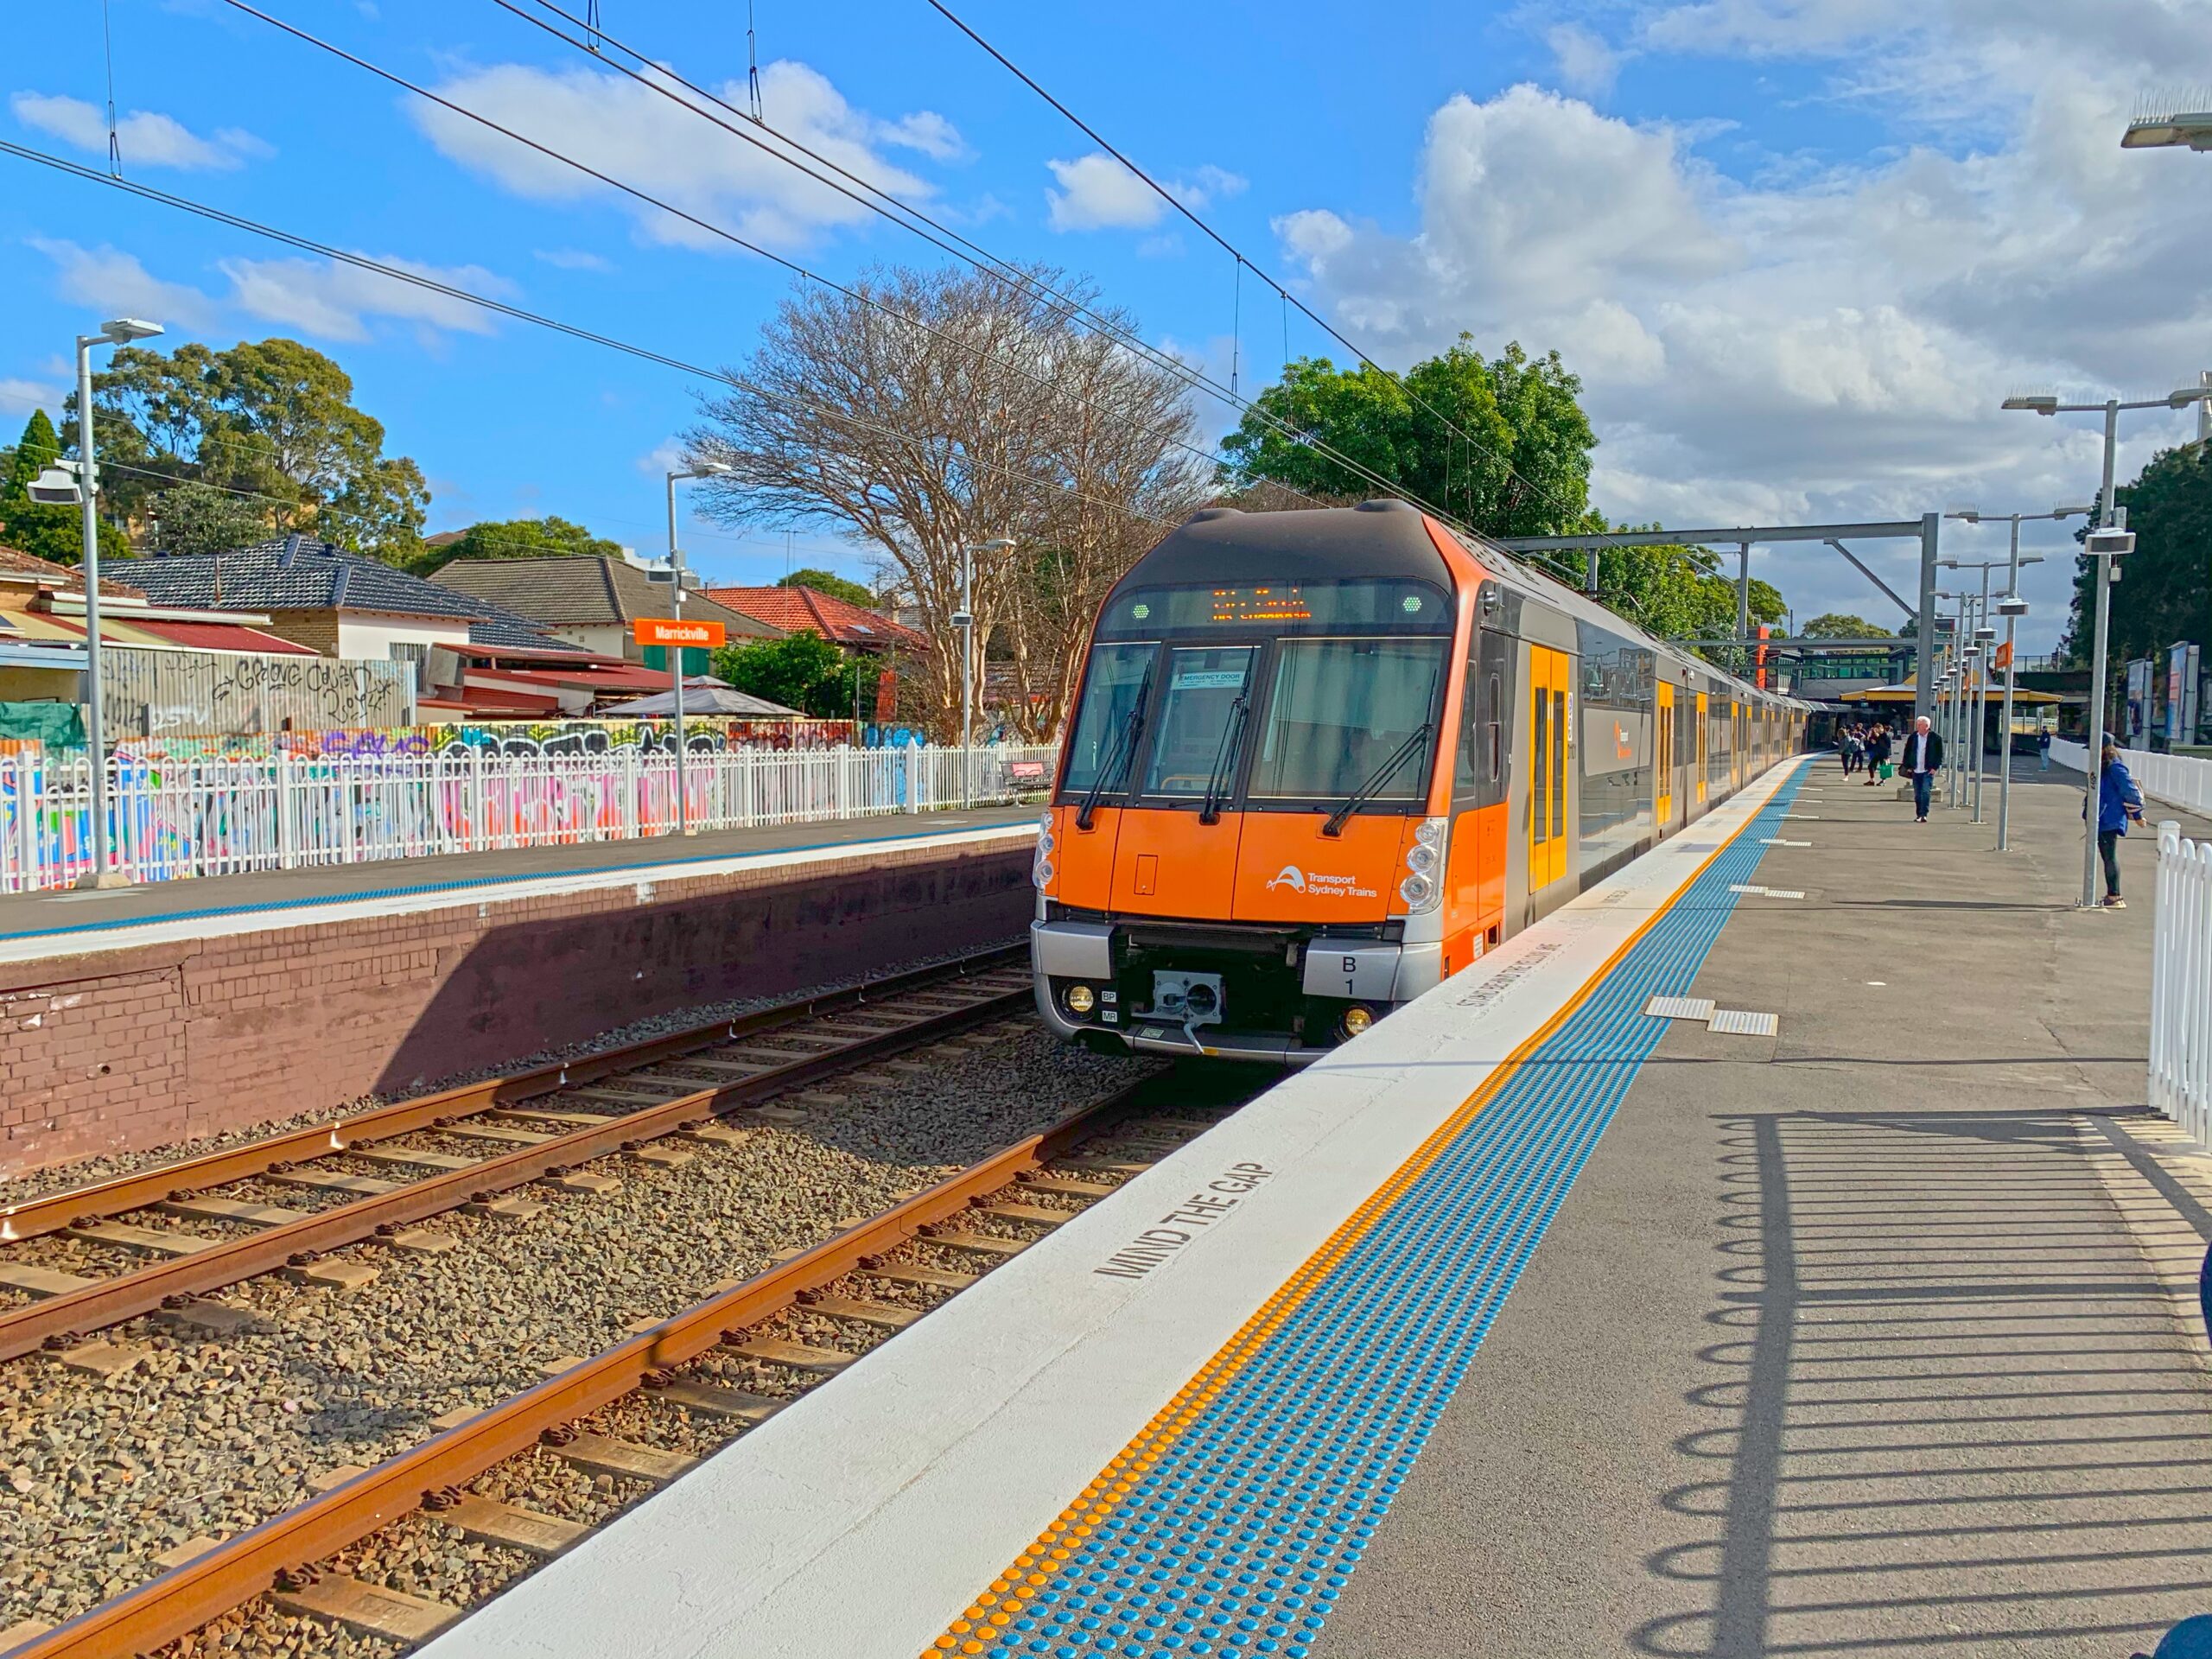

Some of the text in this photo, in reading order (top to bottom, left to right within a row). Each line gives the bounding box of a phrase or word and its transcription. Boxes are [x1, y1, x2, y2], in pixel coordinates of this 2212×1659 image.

[655, 625, 709, 641] Marrickville
[1307, 873, 1356, 885] Transport
[1307, 884, 1377, 898] Sydney Trains
[1343, 956, 1357, 973] B
[1344, 978, 1353, 995] 1
[1103, 992, 1115, 1001] BP
[1103, 1012, 1116, 1021] MR
[1092, 1162, 1273, 1280] MIND THE GAP
